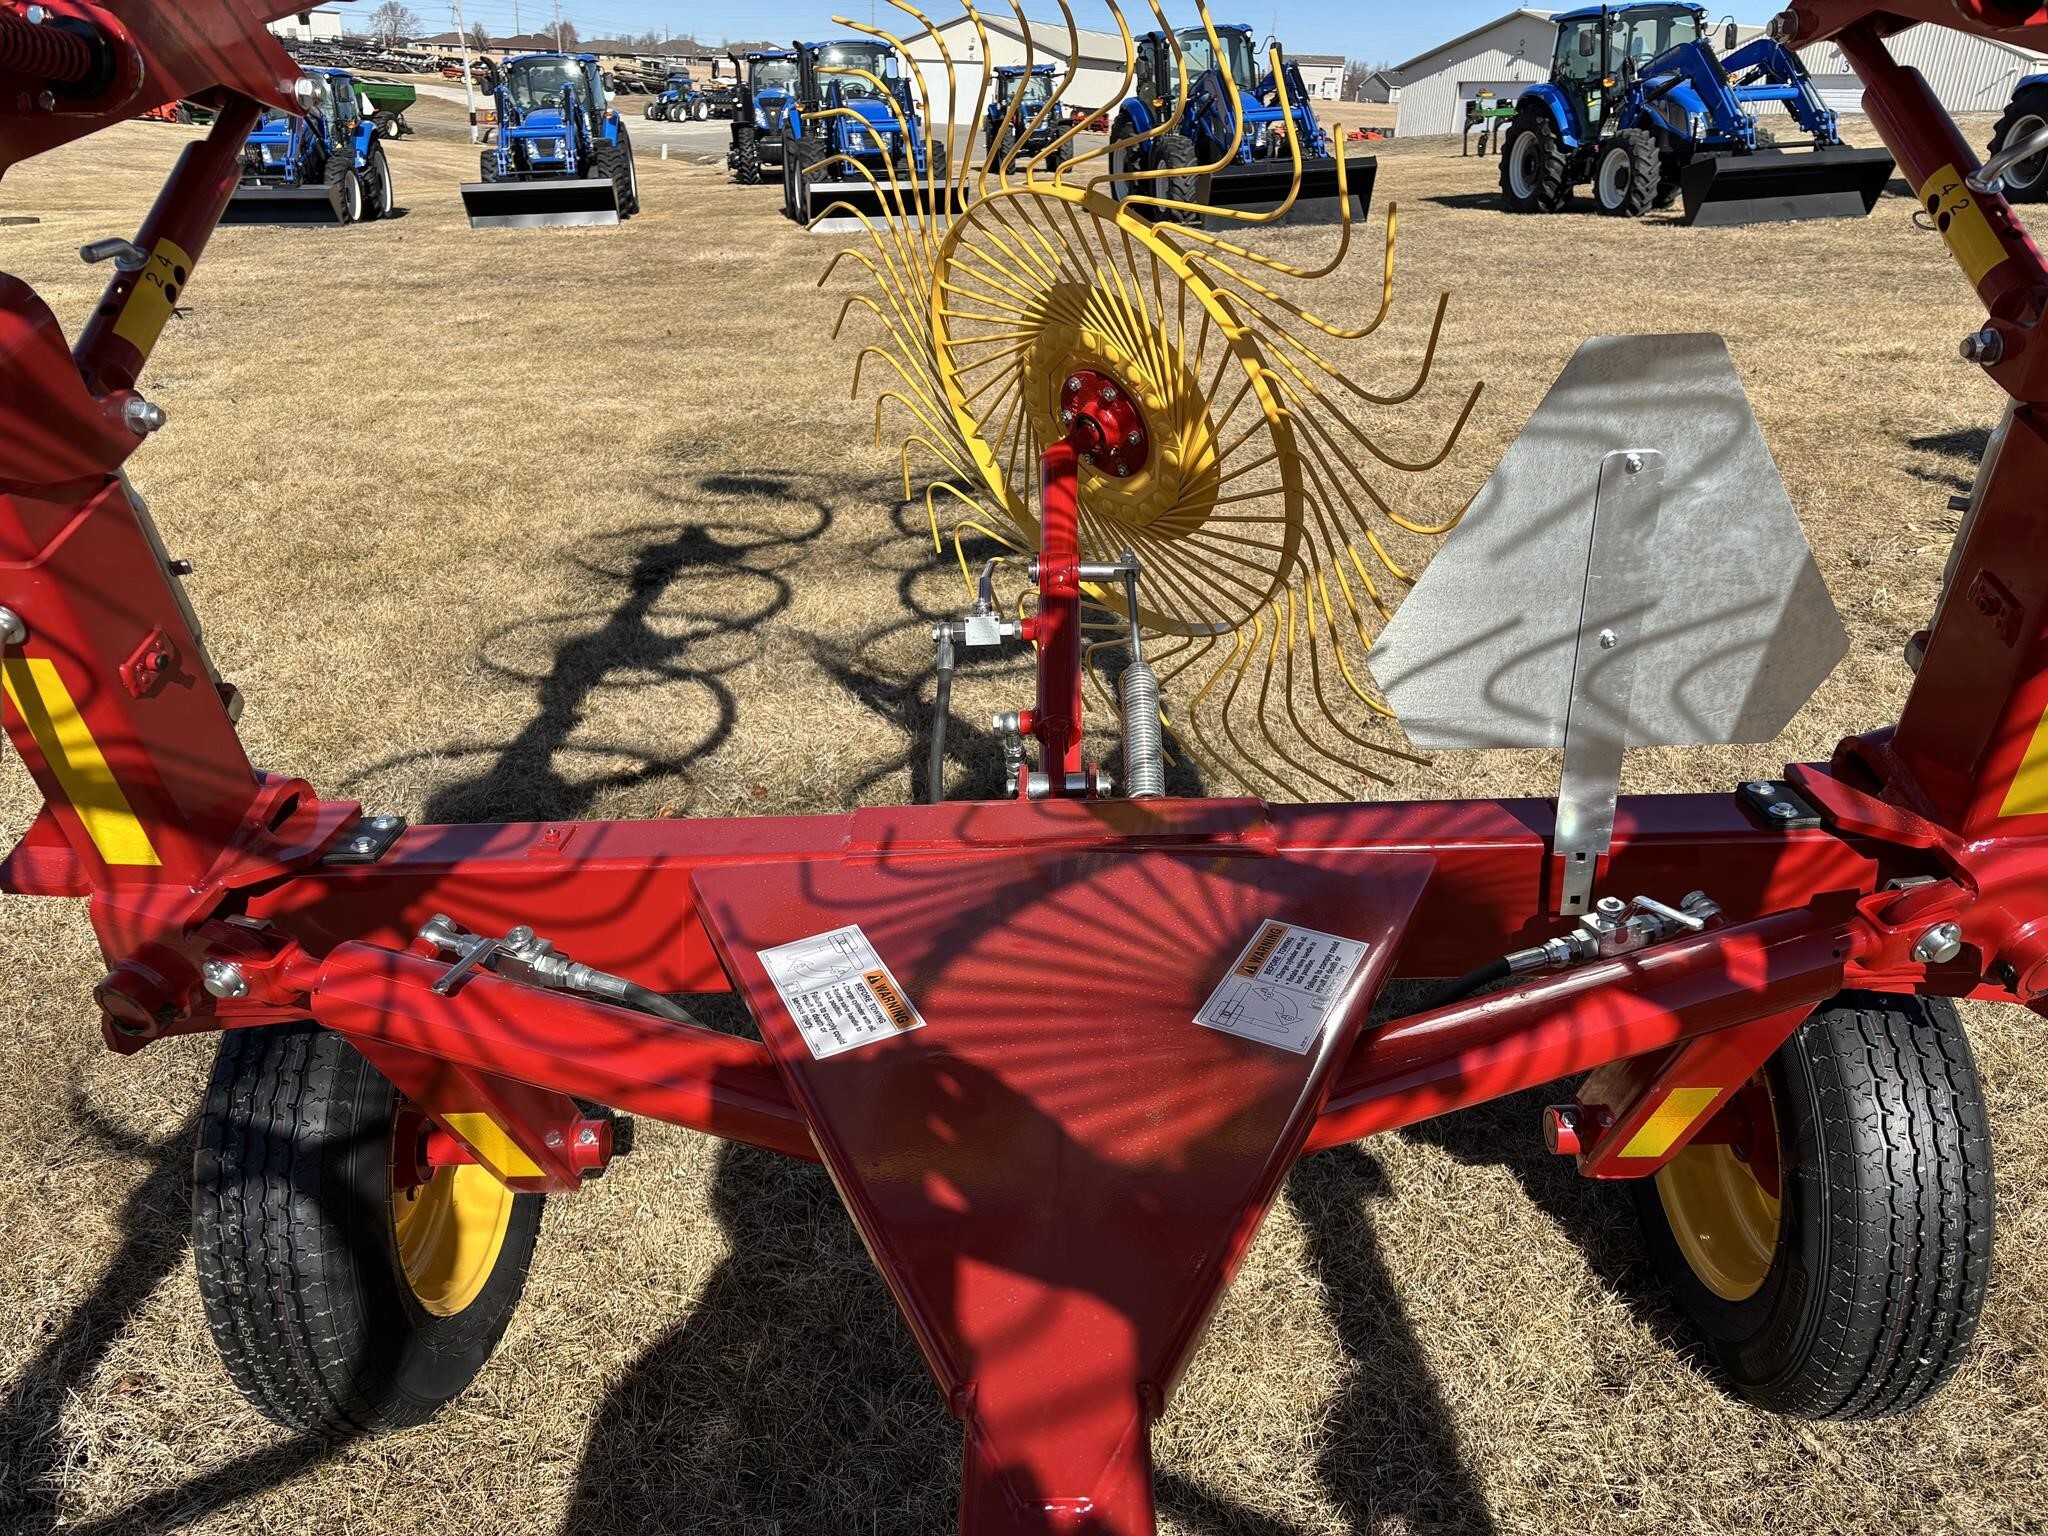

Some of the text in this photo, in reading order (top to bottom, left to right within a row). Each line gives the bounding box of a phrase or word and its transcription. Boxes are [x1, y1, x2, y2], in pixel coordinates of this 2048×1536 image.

[1942, 183, 1970, 217] 4 2
[145, 254, 174, 289] 2 4
[1250, 928, 1281, 962] WARNING
[1264, 937, 1293, 974] BEFORE TOWING
[1275, 965, 1289, 978] Charge
[1286, 950, 1298, 965] cylinder
[1296, 942, 1304, 950] with
[1286, 969, 1299, 982] Rotate
[1296, 959, 1305, 968] valve
[1301, 946, 1313, 959] handle
[1294, 960, 1315, 984] lock position.
[1304, 975, 1319, 990] Failure
[1319, 954, 1334, 969] comply
[1329, 941, 1340, 953] could
[1315, 979, 1327, 993] result
[1326, 962, 1338, 974] death
[792, 997, 813, 1029] serious injury.
[801, 994, 813, 1008] result
[812, 1013, 823, 1027] death
[810, 991, 823, 1007] Failure
[823, 1013, 837, 1030] comply
[833, 1030, 846, 1044] could
[824, 991, 842, 1017] lock position.
[834, 989, 843, 1002] Rotate
[840, 1001, 850, 1012] valve
[847, 1012, 858, 1026] handle
[843, 986, 855, 999] Charge
[852, 1000, 865, 1015] cylinder
[862, 1016, 871, 1024] with
[855, 983, 886, 1023] BEFORE TOWING
[876, 984, 907, 1023] WARNING
